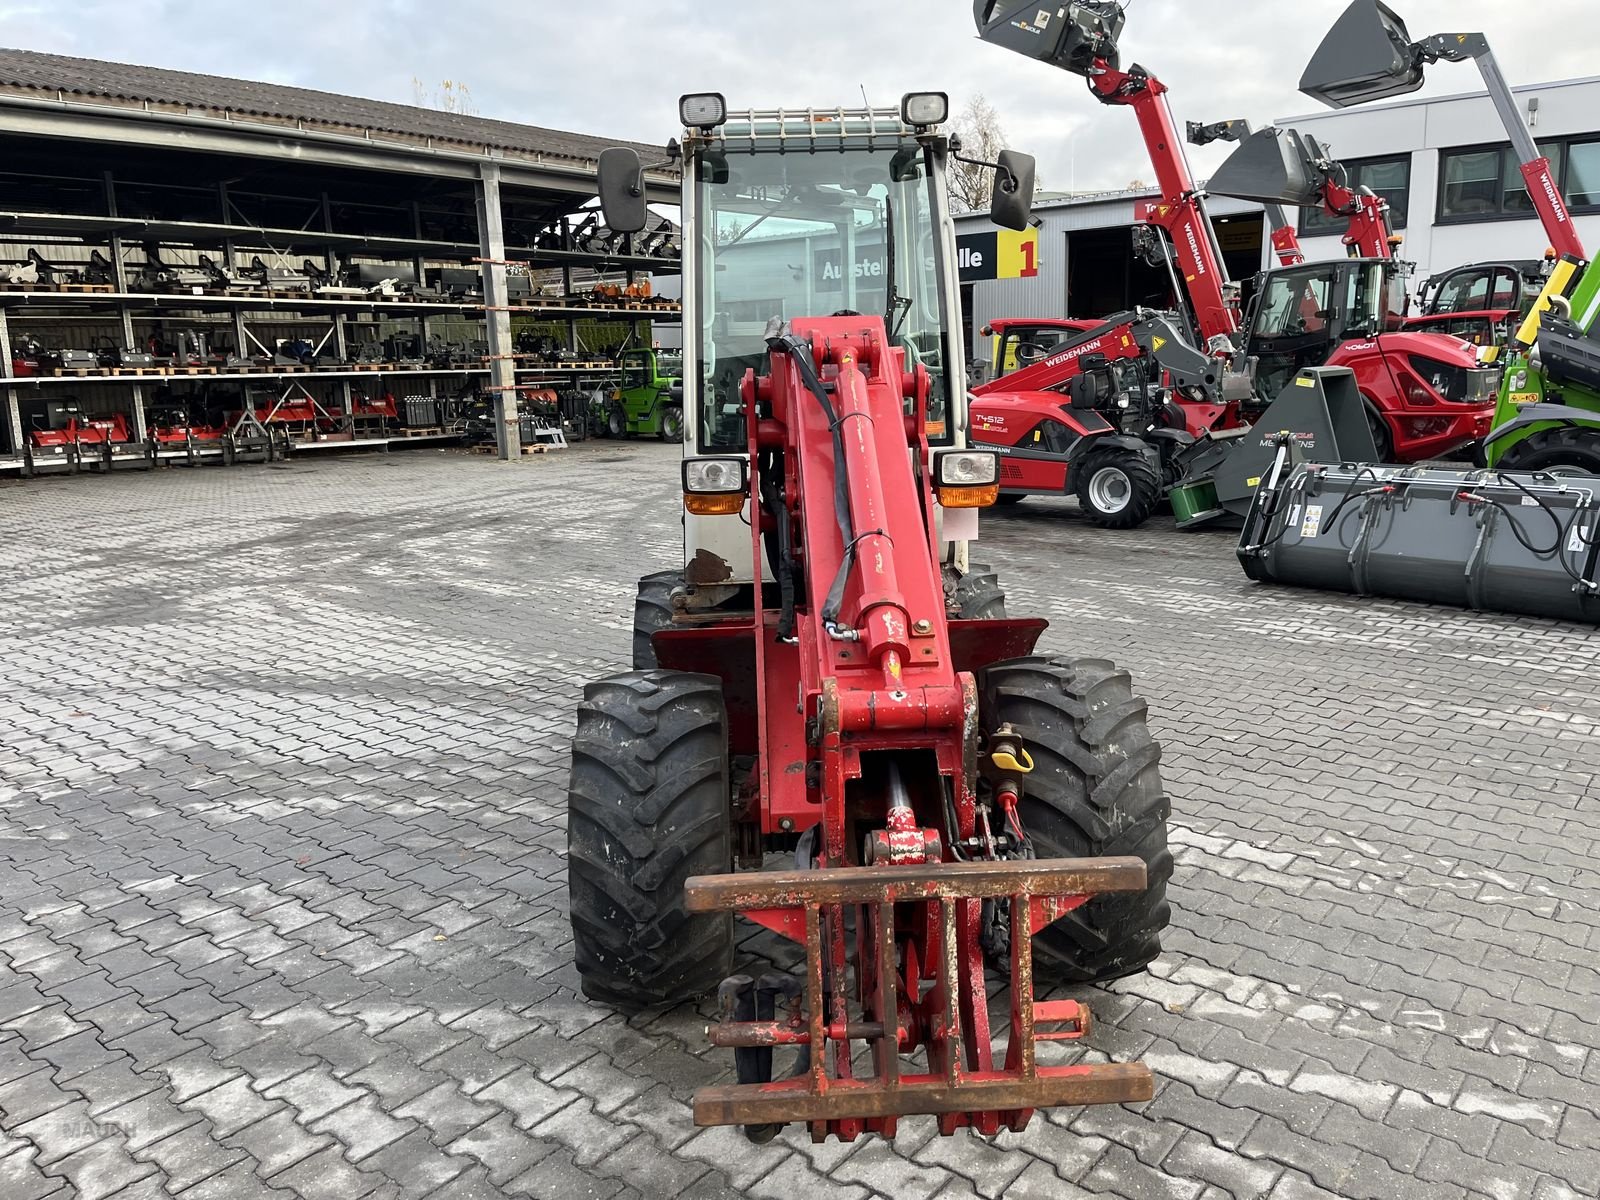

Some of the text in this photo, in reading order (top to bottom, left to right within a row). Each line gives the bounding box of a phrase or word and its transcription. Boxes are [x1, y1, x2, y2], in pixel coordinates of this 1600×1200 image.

[1540, 172, 1566, 223] WEIDEMANN
[1020, 241, 1038, 277] 1
[1184, 222, 1206, 275] WEIDEMANN
[1045, 340, 1101, 368] WEIDEMANN
[975, 414, 1005, 425] T4512
